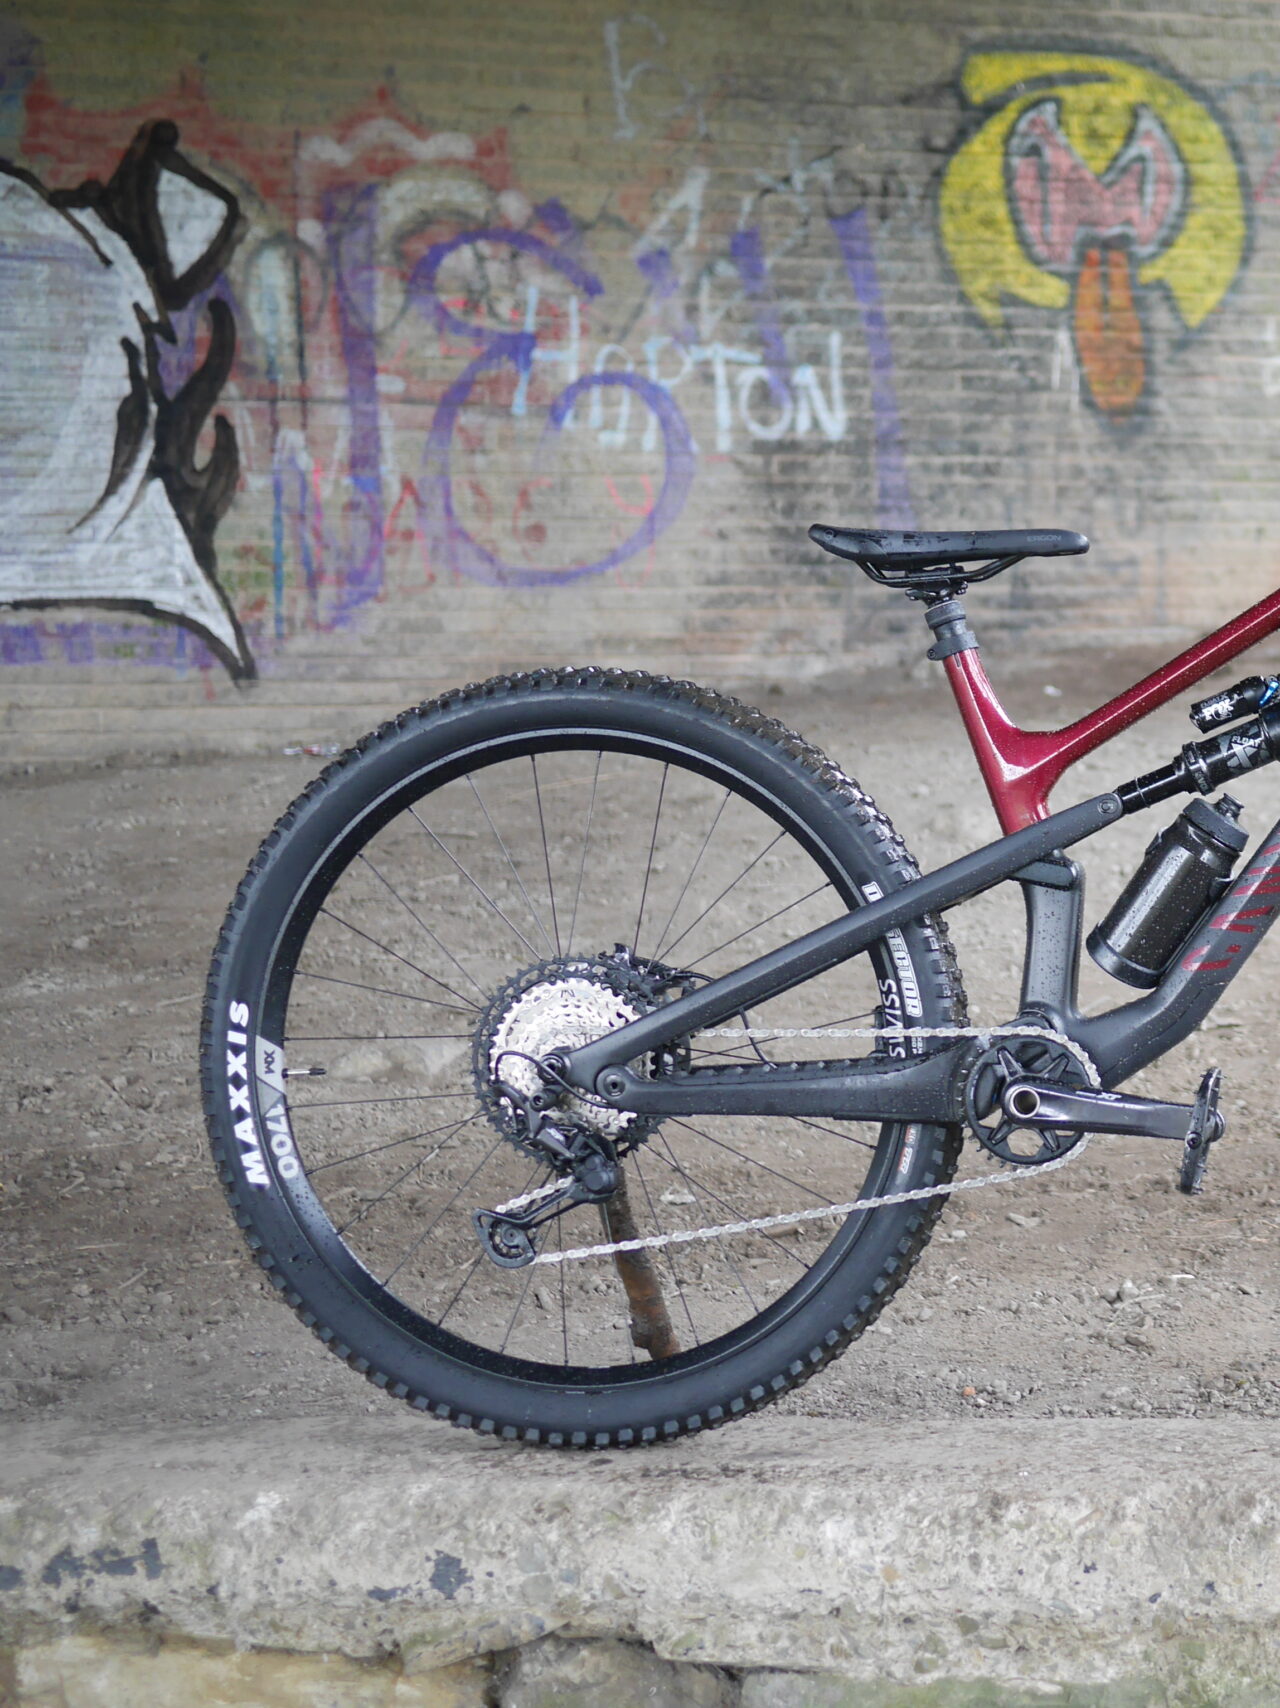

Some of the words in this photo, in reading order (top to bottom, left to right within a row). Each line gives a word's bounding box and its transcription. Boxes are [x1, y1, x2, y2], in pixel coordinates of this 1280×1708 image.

[1026, 534, 1062, 542] ERGON
[1231, 735, 1262, 748] FLOAT
[263, 1050, 276, 1075] XM
[226, 1000, 271, 1186] MAXXIS
